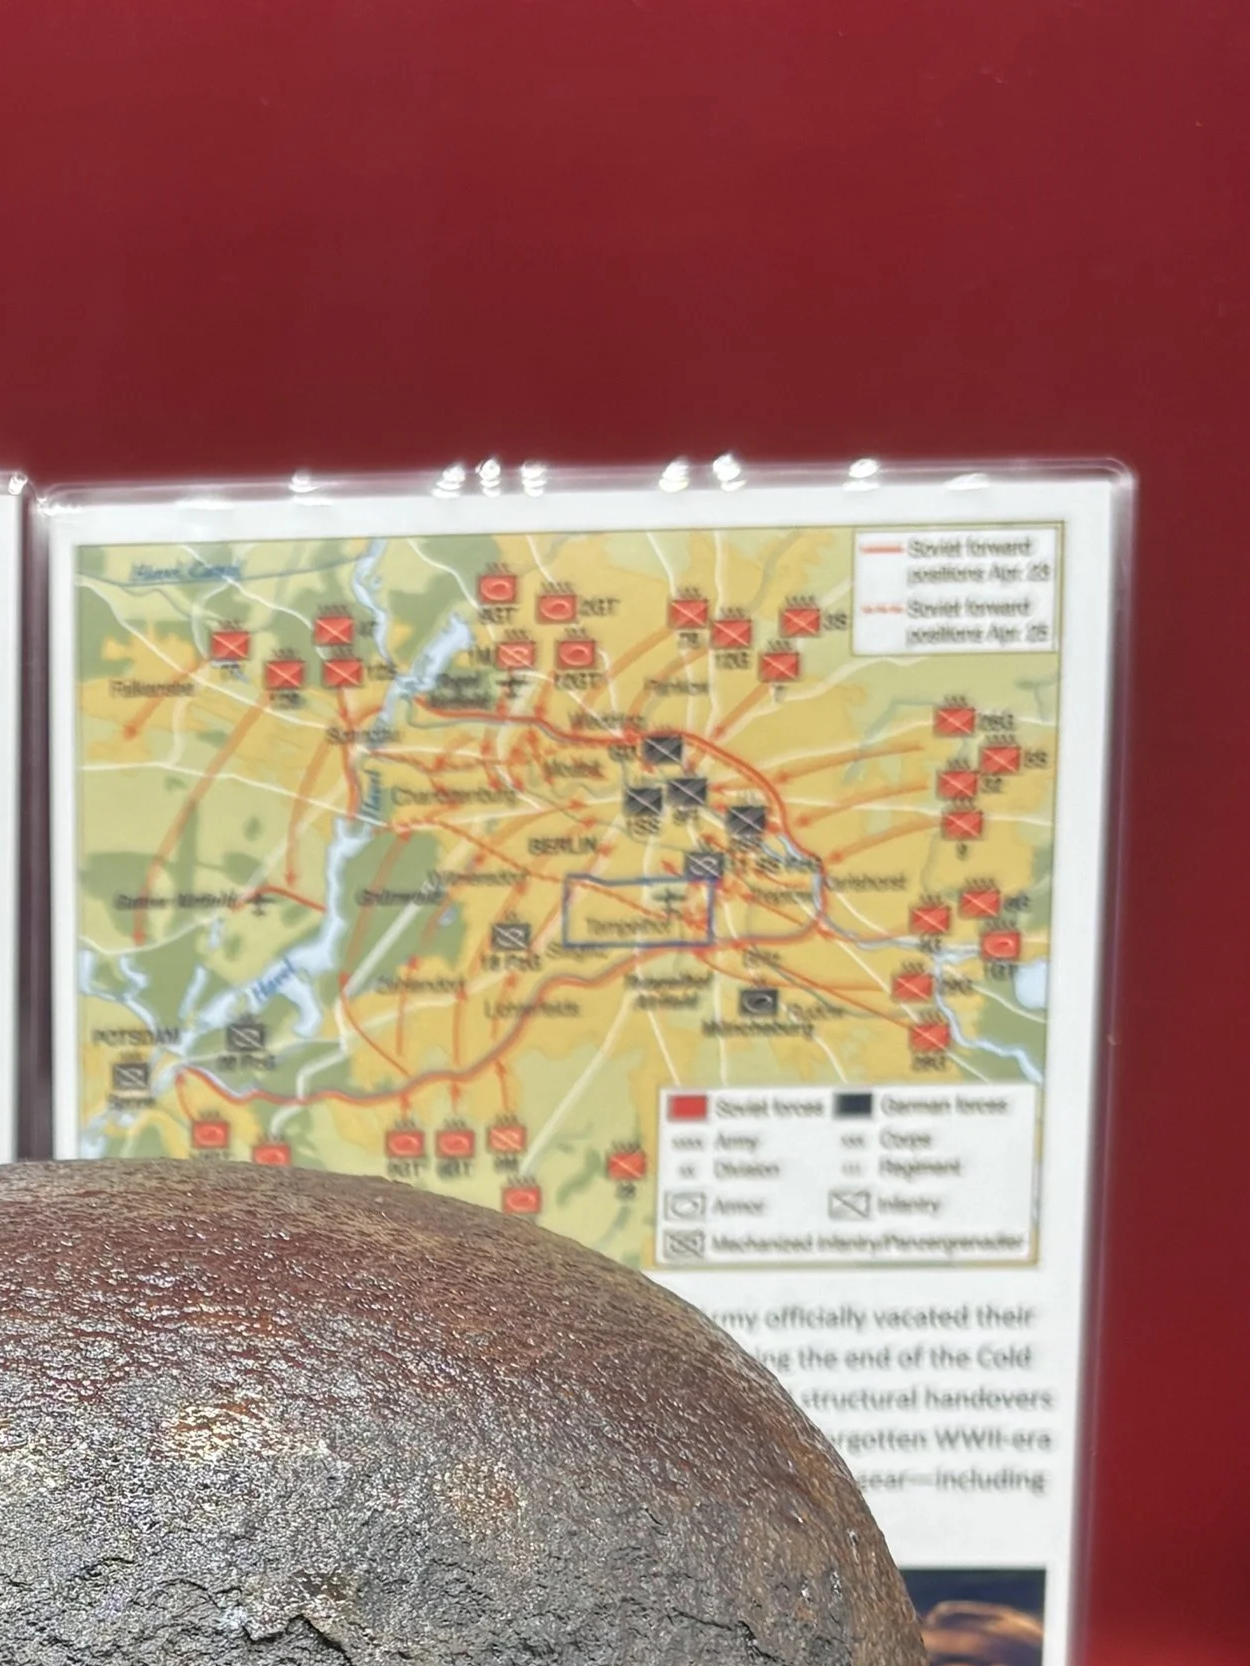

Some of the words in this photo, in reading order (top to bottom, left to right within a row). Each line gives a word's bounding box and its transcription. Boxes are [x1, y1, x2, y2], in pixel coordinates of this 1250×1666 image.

[714, 1133, 758, 1152] Army
[713, 1308, 758, 1334] rmy
[765, 1306, 868, 1333] officially
[875, 1306, 969, 1329] vacated
[977, 1305, 1032, 1328] their
[798, 1346, 839, 1370] the
[844, 1346, 892, 1370] end
[897, 1346, 925, 1370] of
[930, 1346, 971, 1370] the
[977, 1346, 1032, 1370] Cold
[924, 1388, 1054, 1410] handovers
[936, 1429, 1053, 1451] WWII-era
